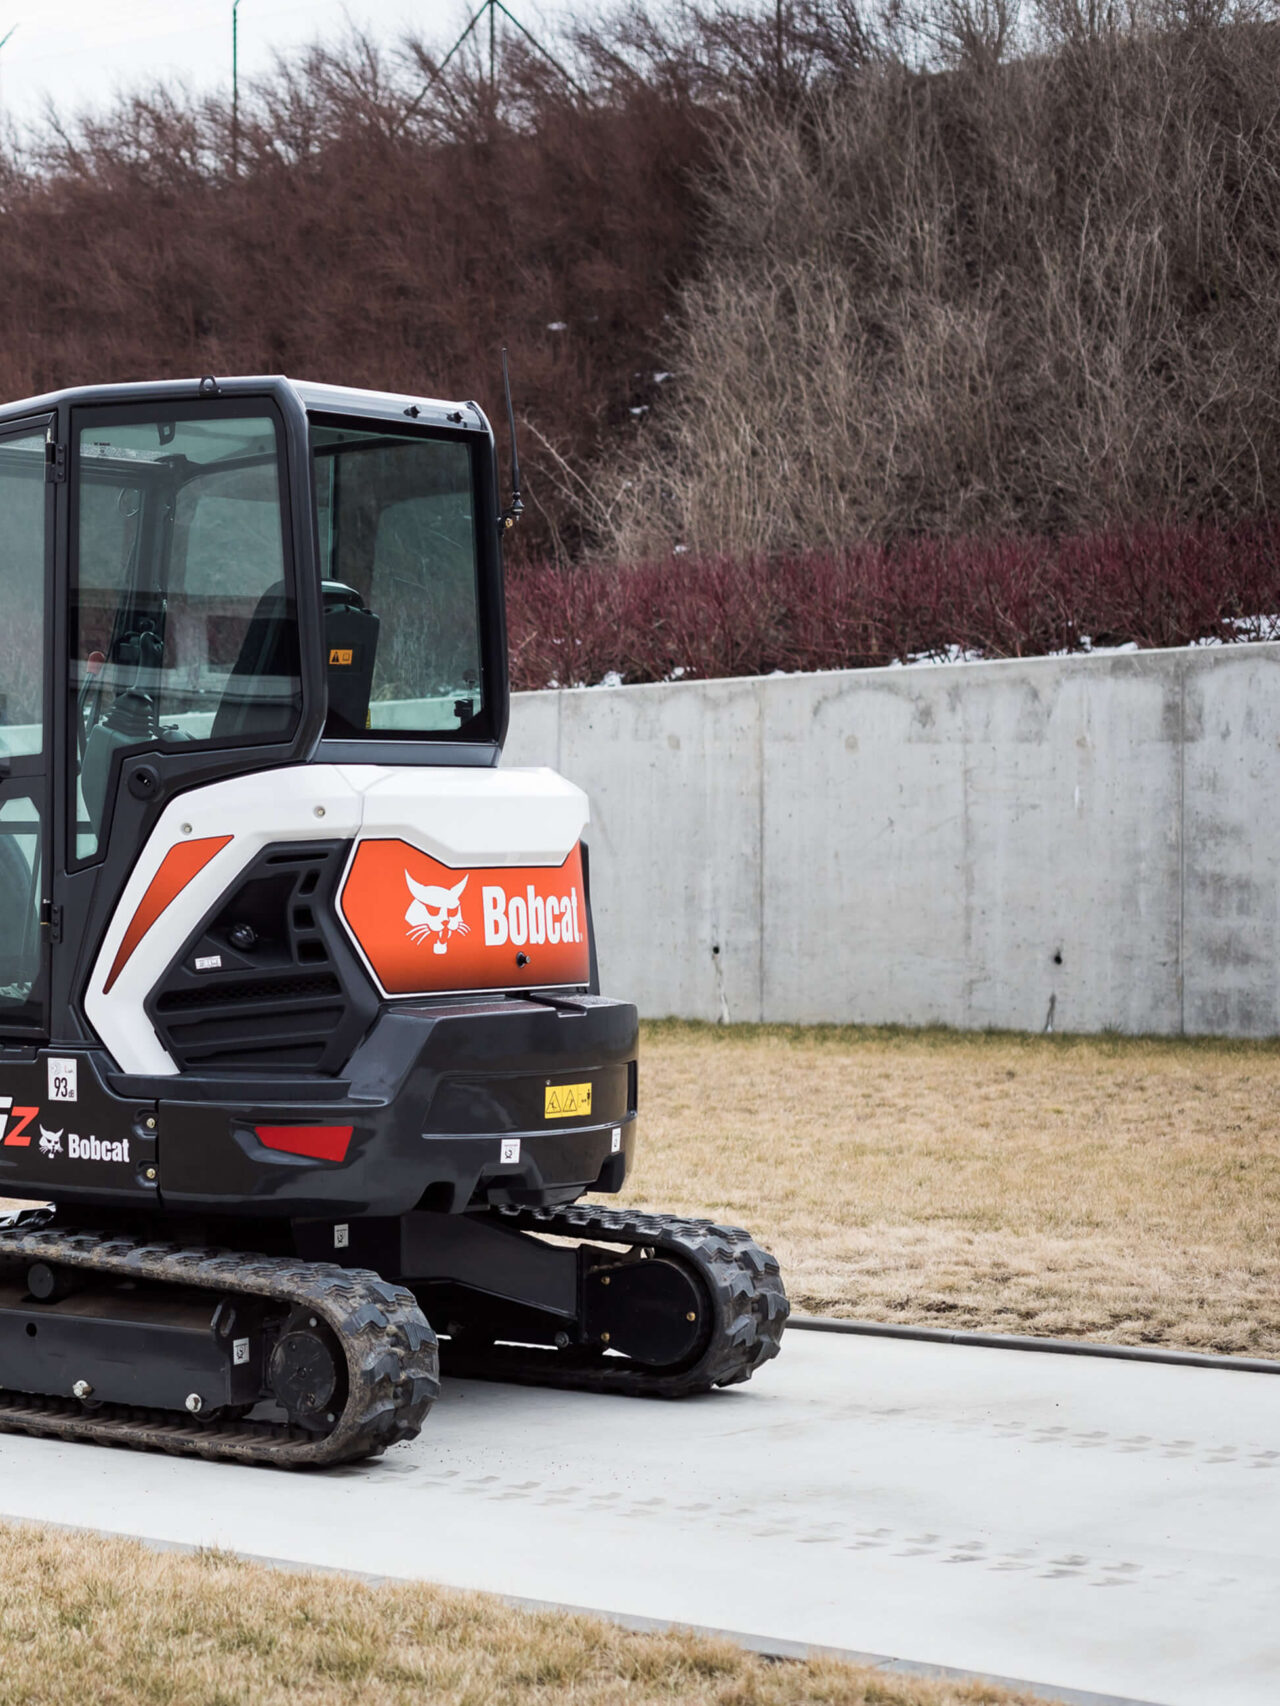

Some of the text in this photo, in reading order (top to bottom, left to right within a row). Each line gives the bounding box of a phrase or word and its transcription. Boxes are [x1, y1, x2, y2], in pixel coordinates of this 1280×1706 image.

[482, 885, 579, 946] Bobcat
[54, 1077, 68, 1097] 93
[68, 1133, 130, 1163] Bobcat
